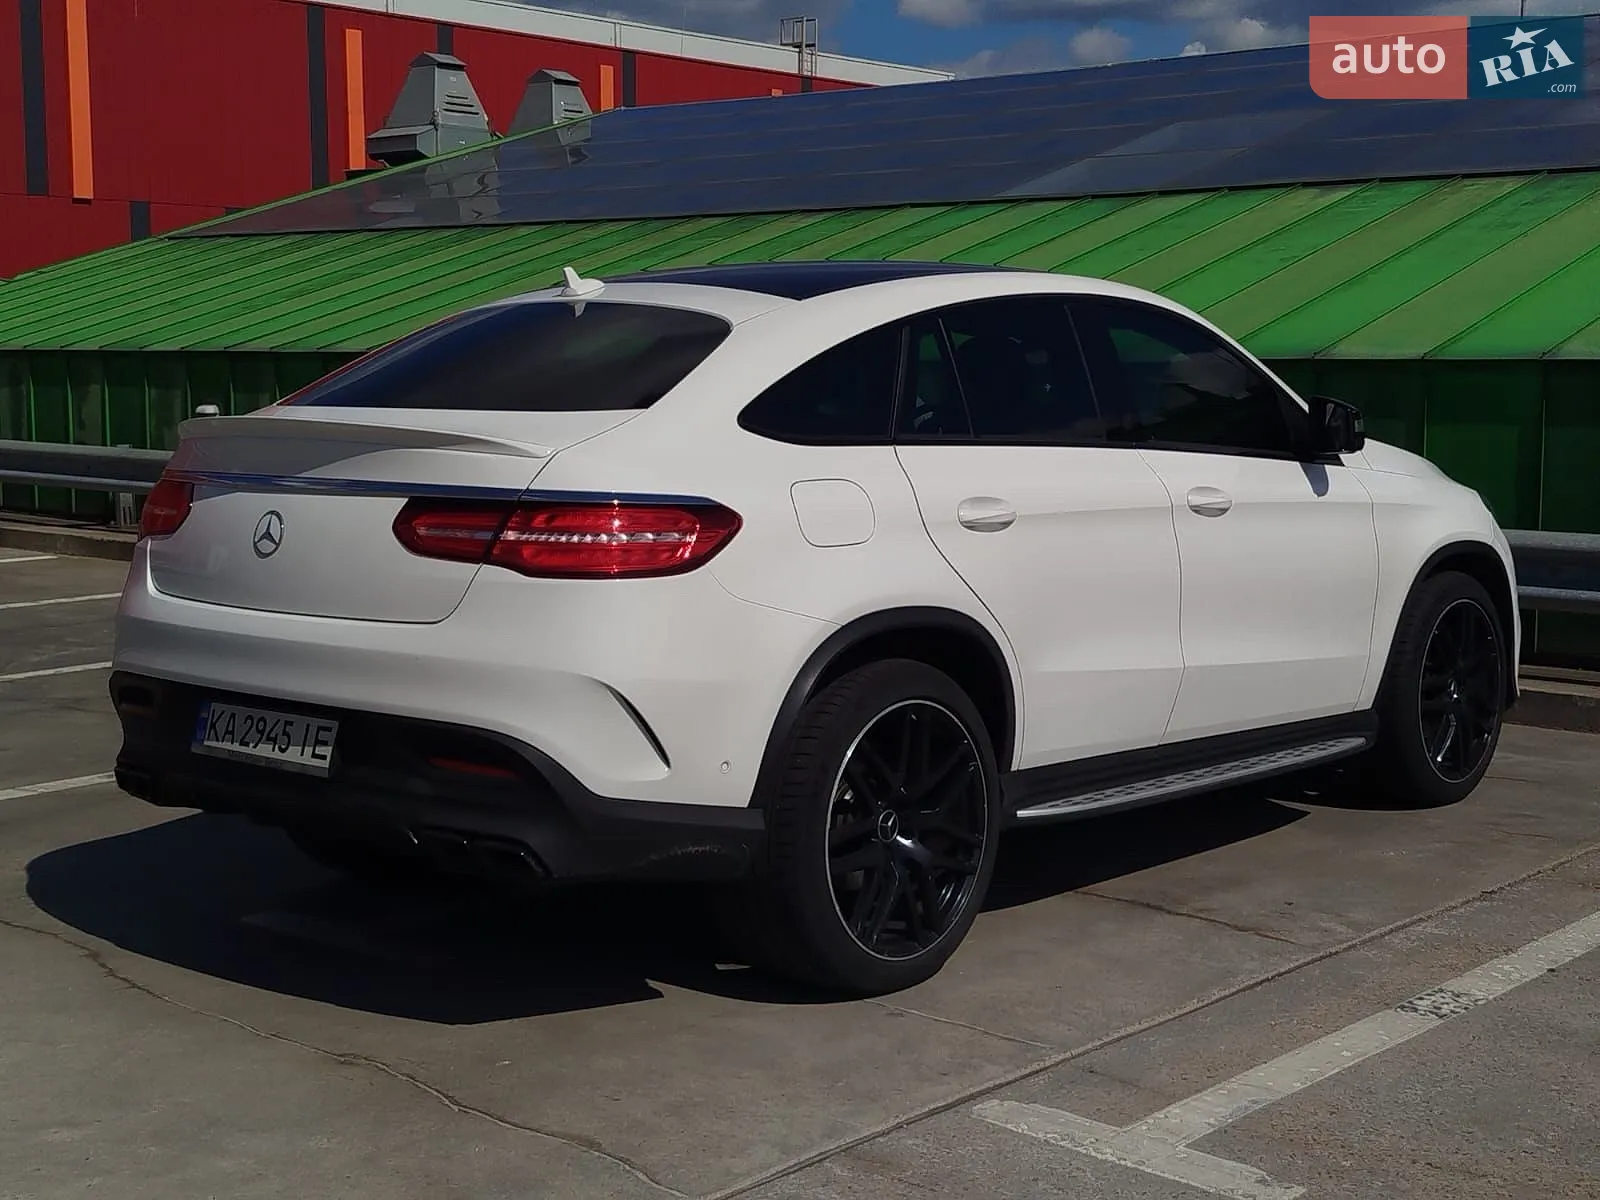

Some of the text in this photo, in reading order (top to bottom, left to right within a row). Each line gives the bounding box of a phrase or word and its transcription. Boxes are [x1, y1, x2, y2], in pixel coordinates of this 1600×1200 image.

[207, 708, 237, 745] KA
[238, 714, 294, 754] 2945
[300, 723, 333, 761] IE
